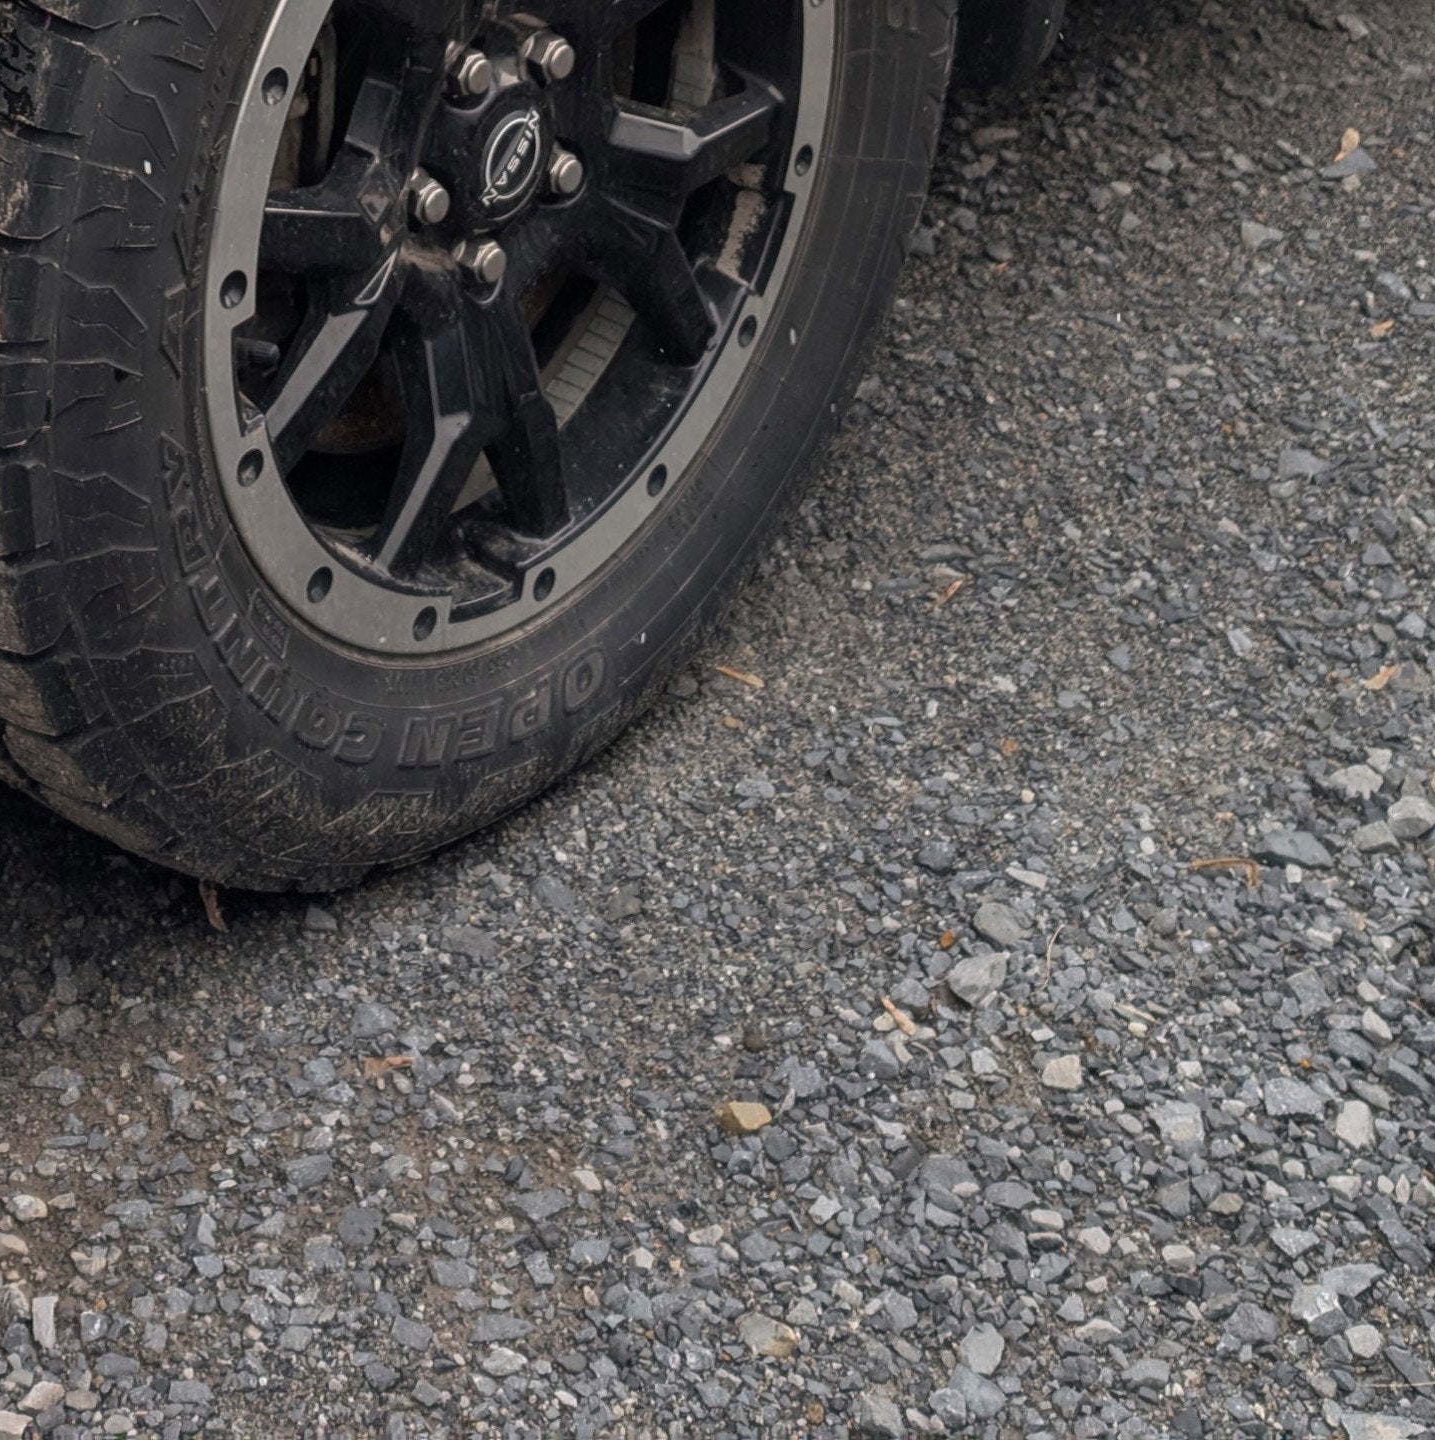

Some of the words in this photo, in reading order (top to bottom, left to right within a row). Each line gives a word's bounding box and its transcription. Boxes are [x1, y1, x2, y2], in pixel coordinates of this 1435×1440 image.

[481, 108, 541, 207] NISSAN
[159, 432, 384, 770] COUNTRY
[396, 644, 609, 772] OPEN
